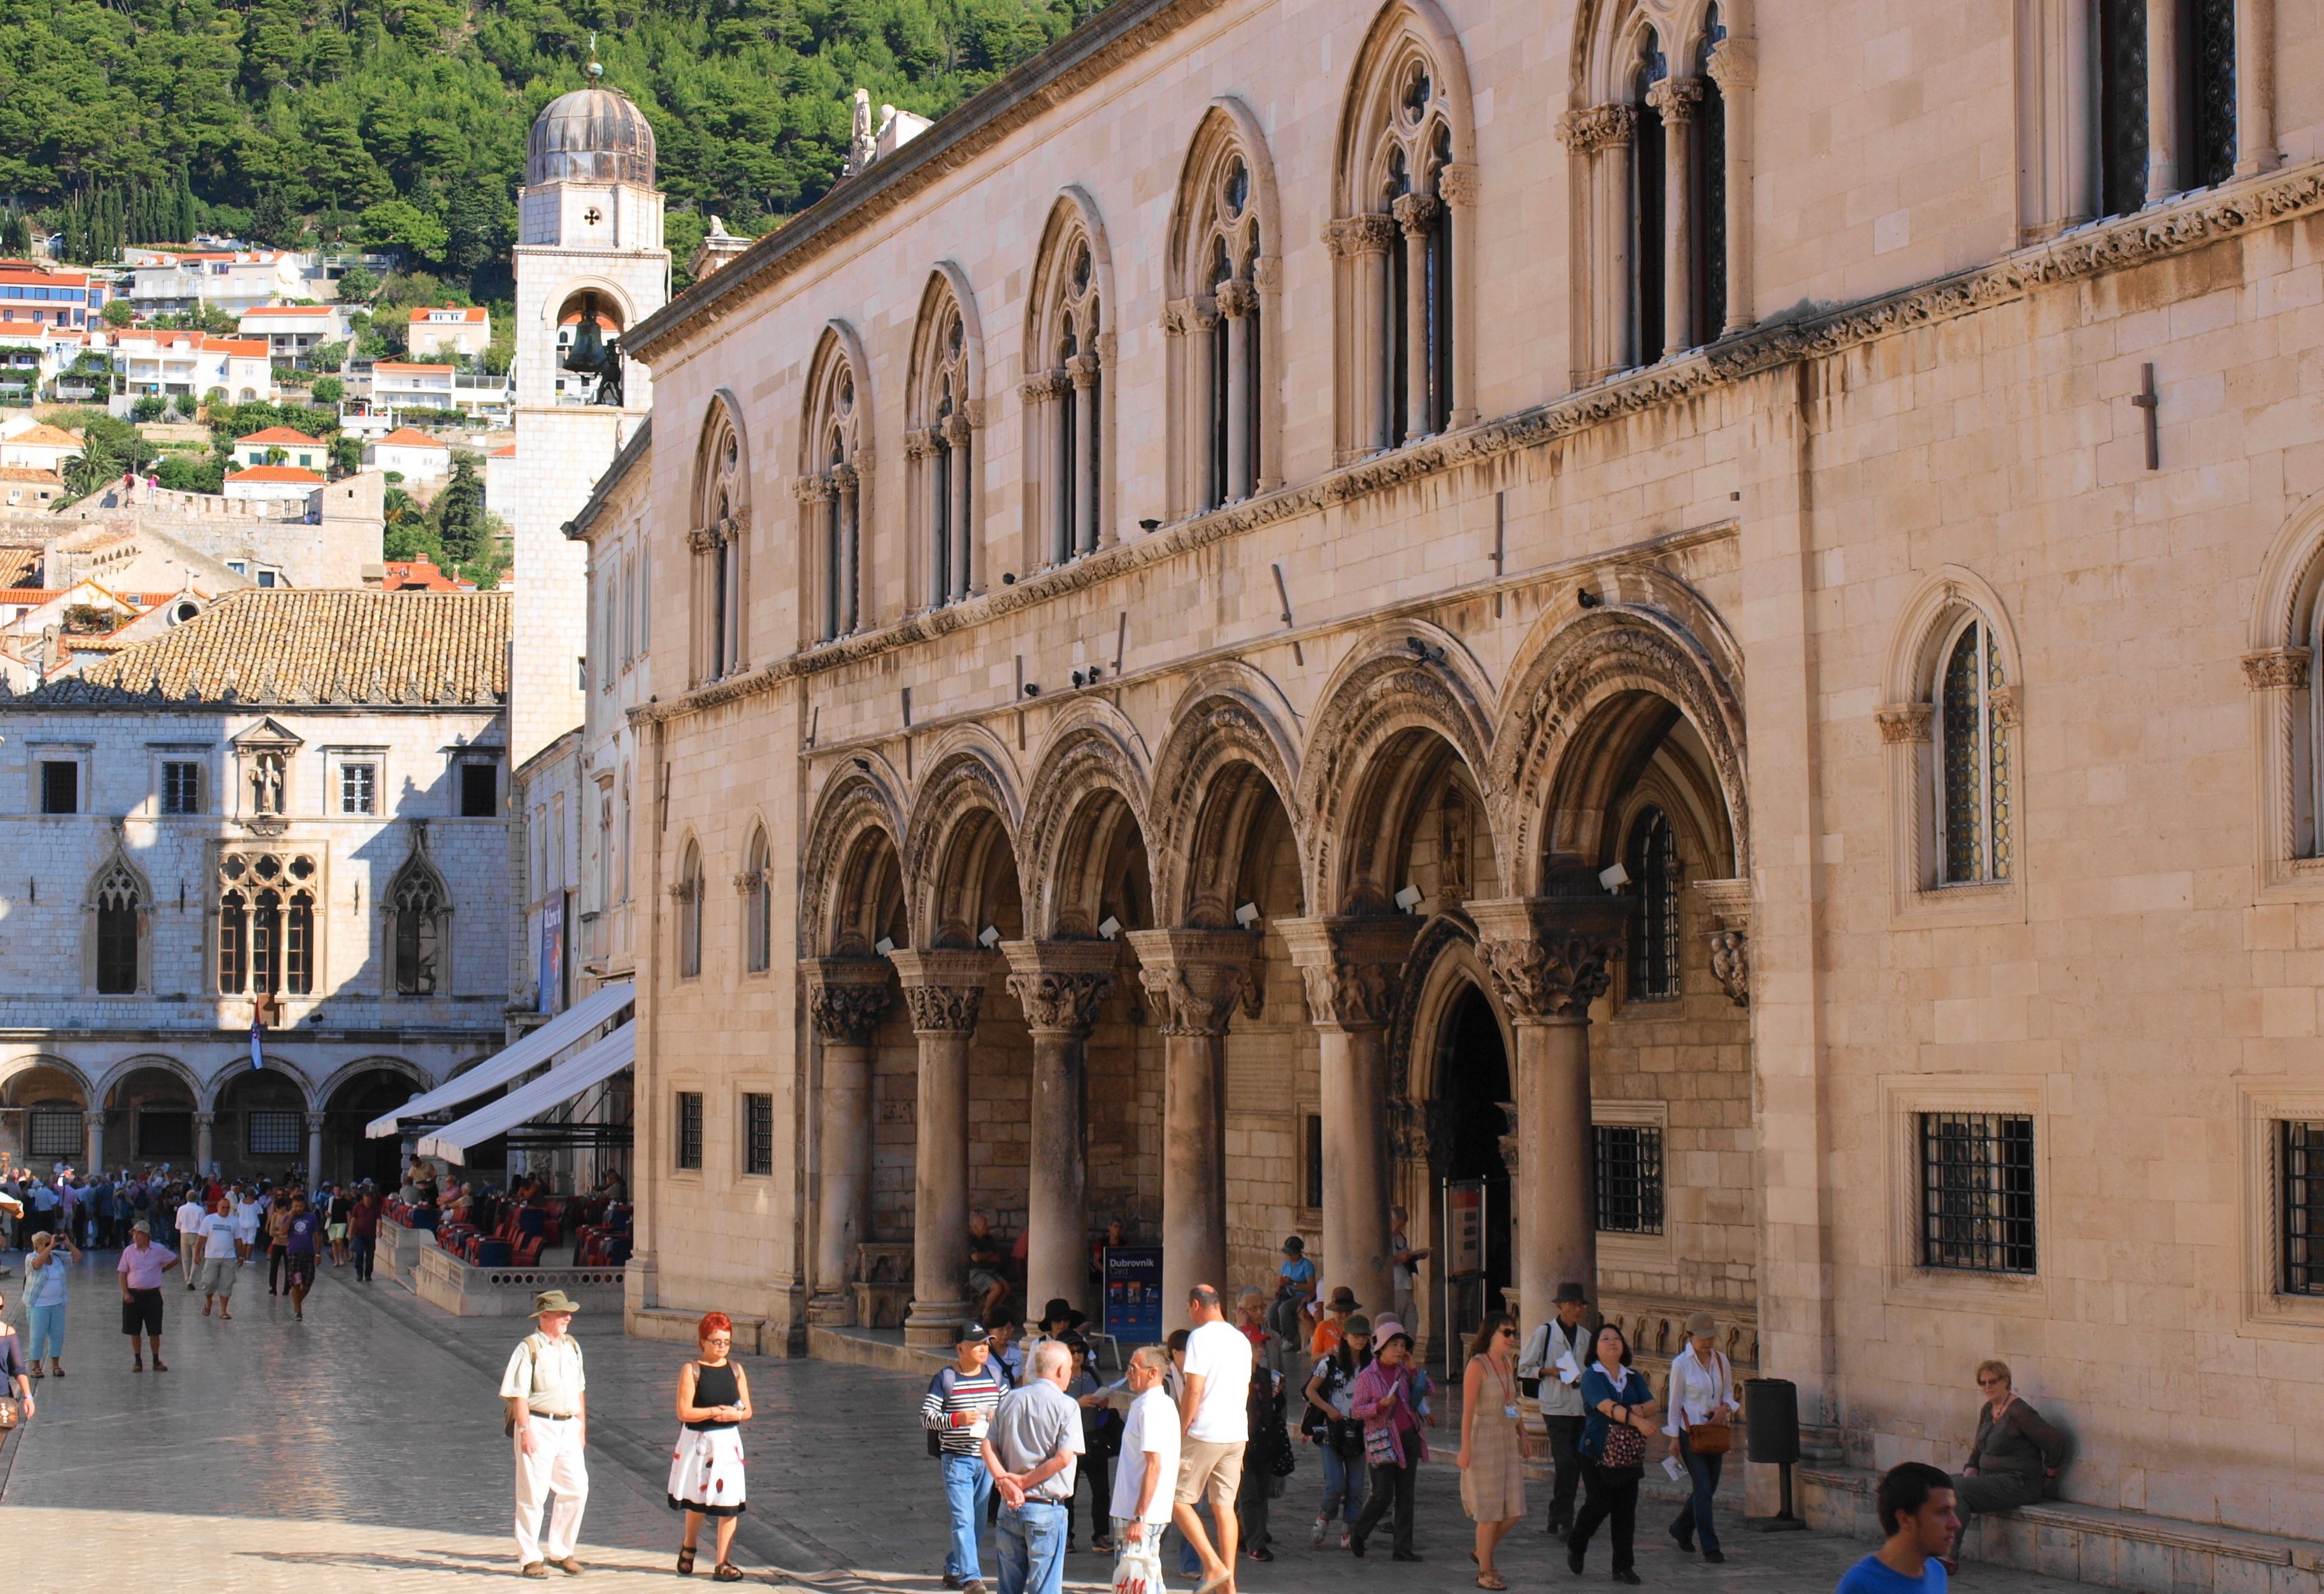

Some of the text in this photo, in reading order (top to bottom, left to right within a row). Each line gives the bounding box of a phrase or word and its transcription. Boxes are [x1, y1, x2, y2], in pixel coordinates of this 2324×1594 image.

[1110, 1259, 1154, 1267] Dubrovnik
[1110, 1288, 1115, 1297] 1
[1128, 1288, 1133, 1297] 3
[1145, 1288, 1151, 1297] 7
